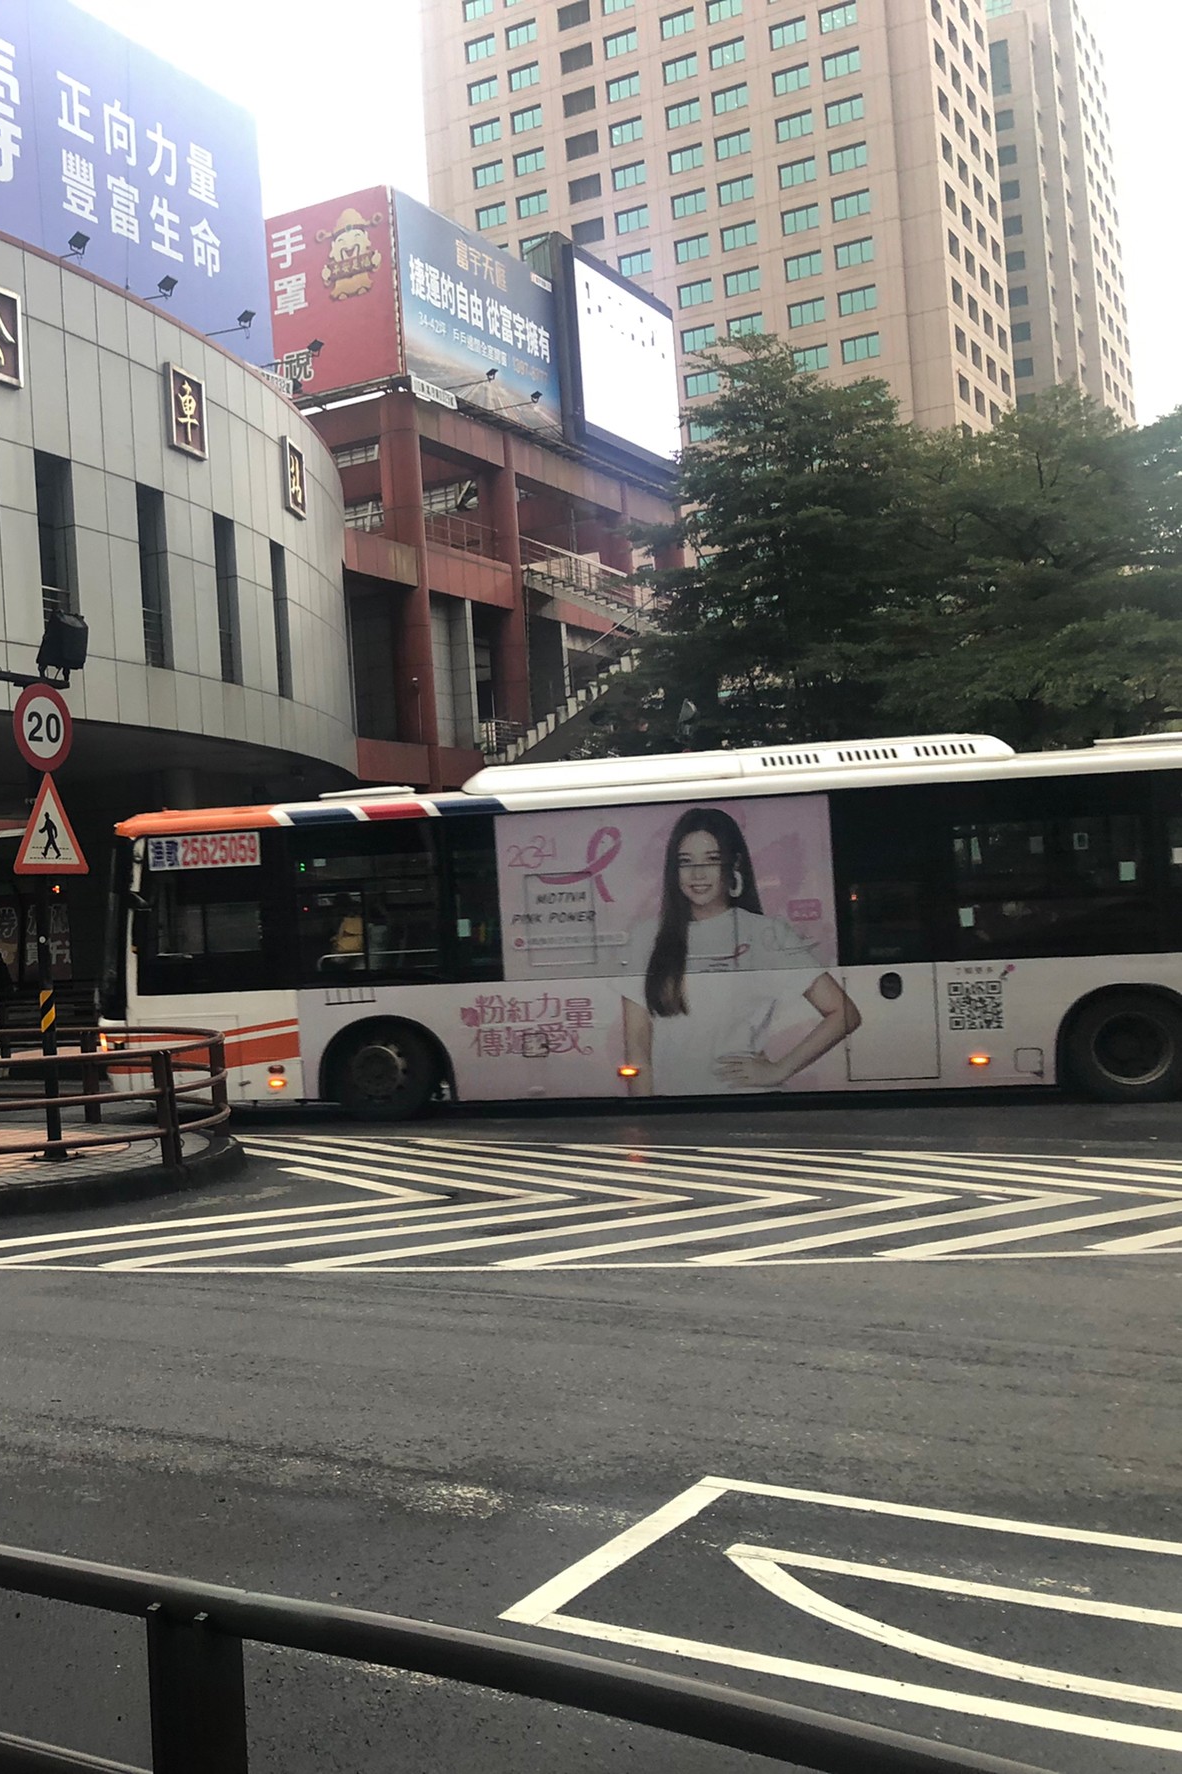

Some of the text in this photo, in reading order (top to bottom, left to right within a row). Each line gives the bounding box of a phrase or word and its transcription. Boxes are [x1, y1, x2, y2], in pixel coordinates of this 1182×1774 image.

[56, 70, 220, 210] 正向力量
[61, 150, 222, 279] 豐富生命
[271, 225, 306, 269] 手
[274, 273, 308, 316] 罩
[408, 253, 551, 364] 捷運的自由 從富宇擁有
[177, 380, 200, 443] 車
[27, 711, 61, 744] 20
[181, 834, 257, 867] 25625059
[511, 909, 597, 925] PINK POWER
[475, 992, 595, 1029] 粉紅力量
